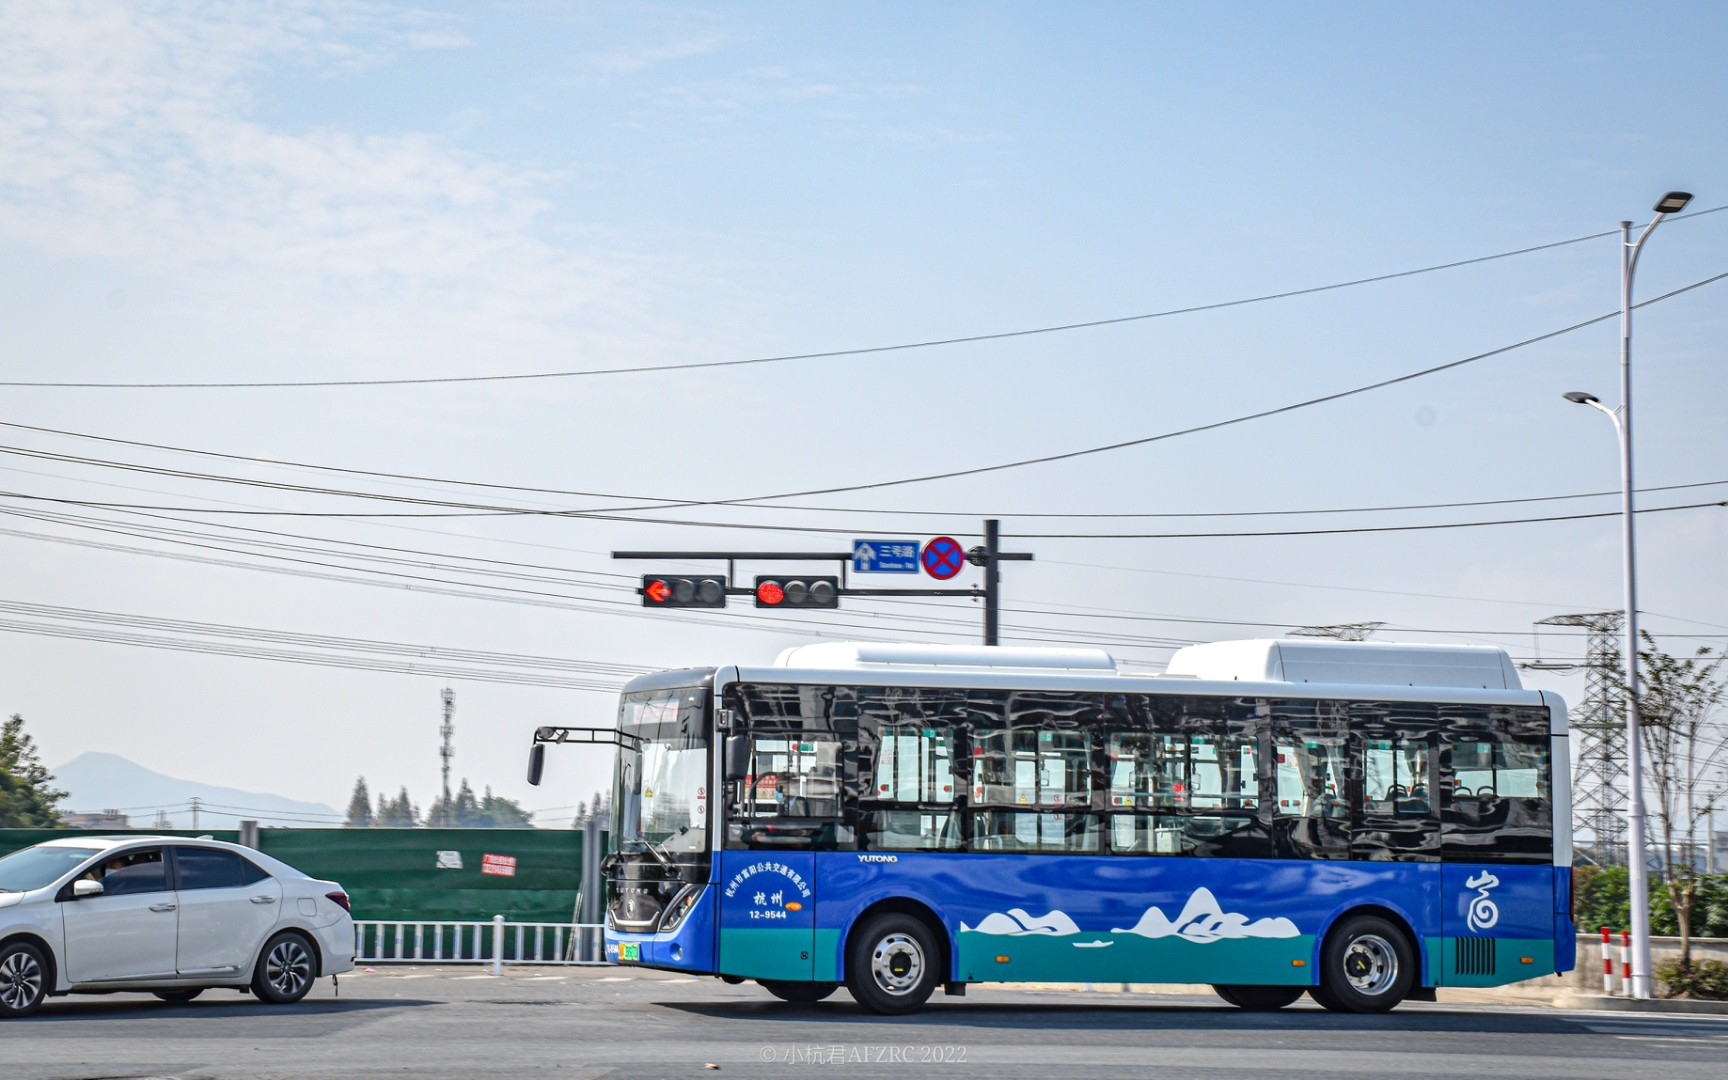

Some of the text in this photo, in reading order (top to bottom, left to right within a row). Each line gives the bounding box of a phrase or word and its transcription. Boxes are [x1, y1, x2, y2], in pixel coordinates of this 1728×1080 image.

[857, 854, 898, 863] YUTONG
[724, 861, 811, 898] 杭州市富阳公共交通有限公司
[749, 910, 787, 919] 12-9544
